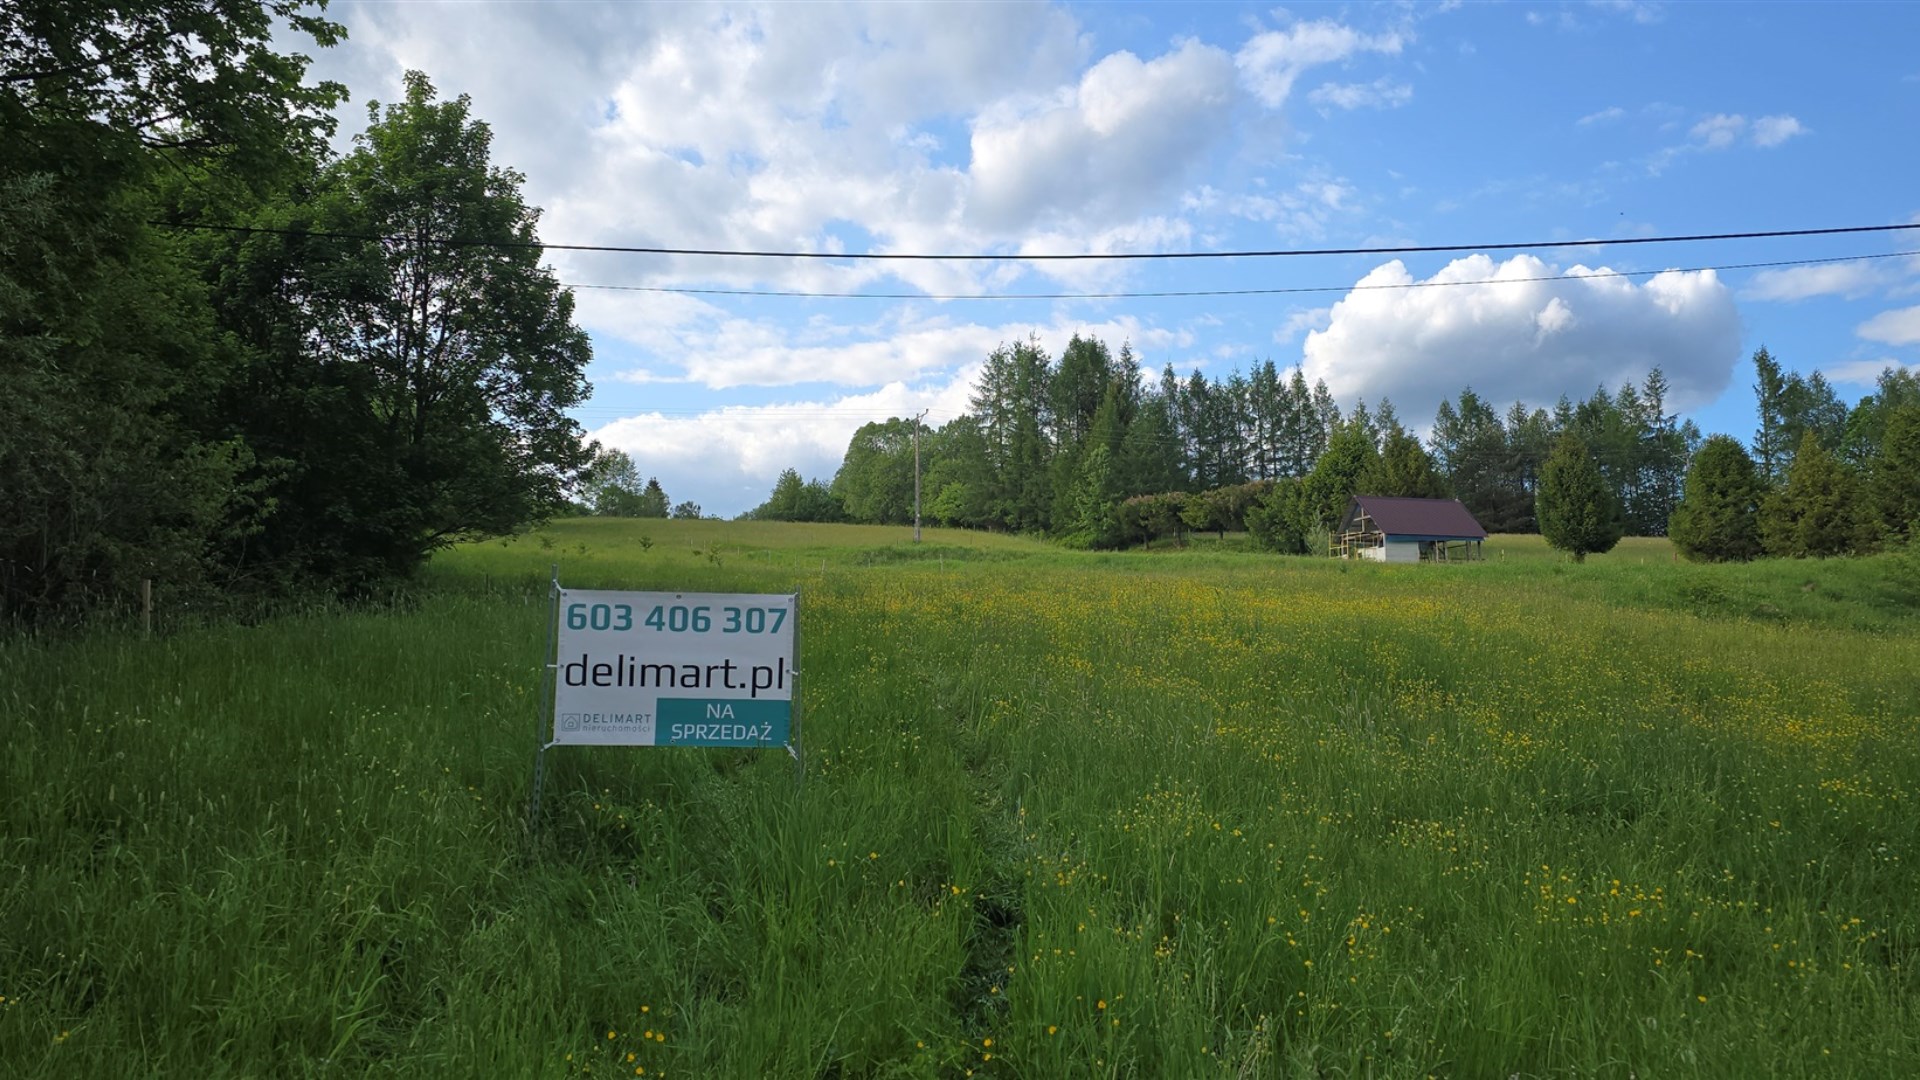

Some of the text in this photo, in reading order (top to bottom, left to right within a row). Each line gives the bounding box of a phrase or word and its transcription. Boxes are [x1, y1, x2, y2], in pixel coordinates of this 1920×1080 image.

[567, 603, 788, 634] 603 406 307
[565, 653, 784, 698] delimart.pl
[583, 713, 651, 724] DELIMART
[706, 703, 735, 719] NA
[582, 724, 650, 733] nieruchomości
[671, 721, 773, 741] SPRZEDAŻ
